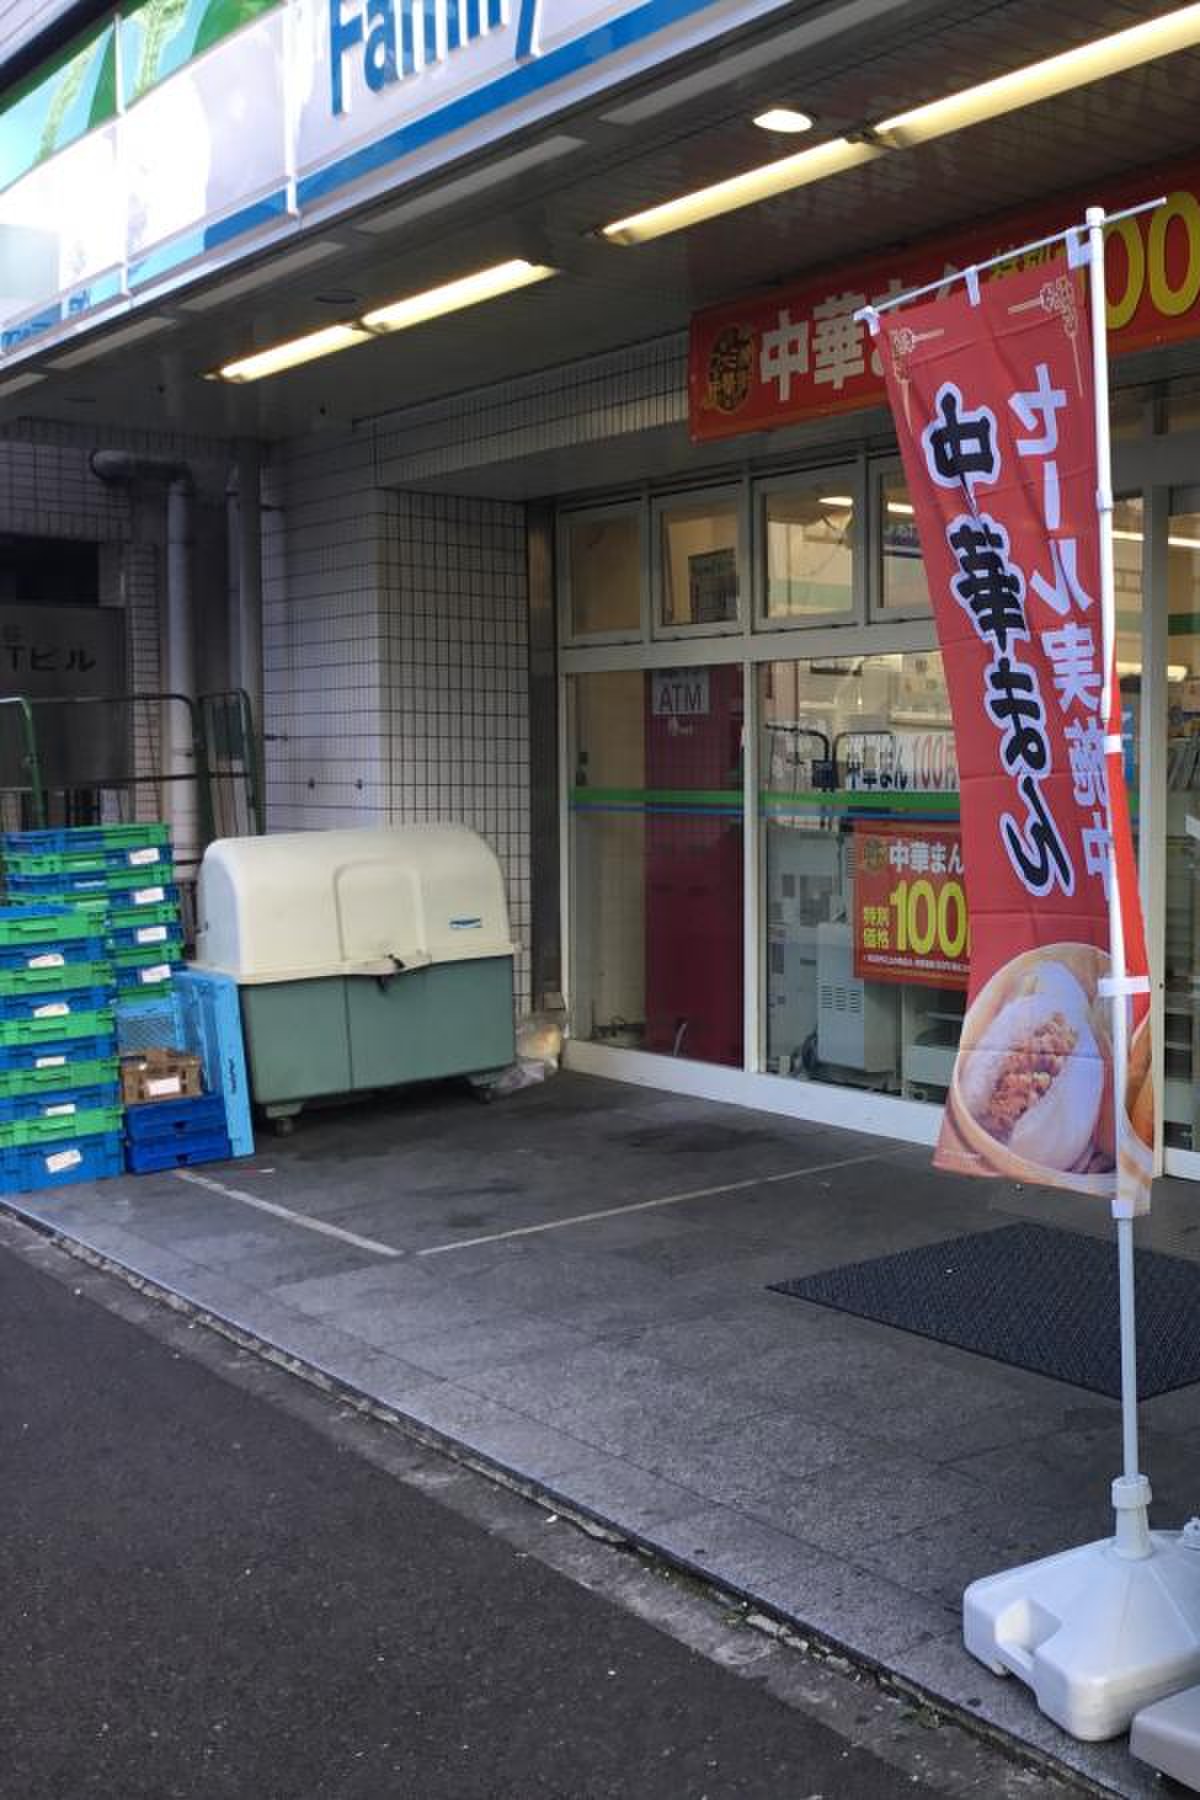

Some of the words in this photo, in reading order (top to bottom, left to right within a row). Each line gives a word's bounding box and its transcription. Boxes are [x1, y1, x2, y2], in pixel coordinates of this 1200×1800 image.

[330, 0, 538, 117] Fam
[660, 684, 702, 712] ATM
[889, 841, 964, 874] 中華まん
[890, 878, 971, 958] 100
